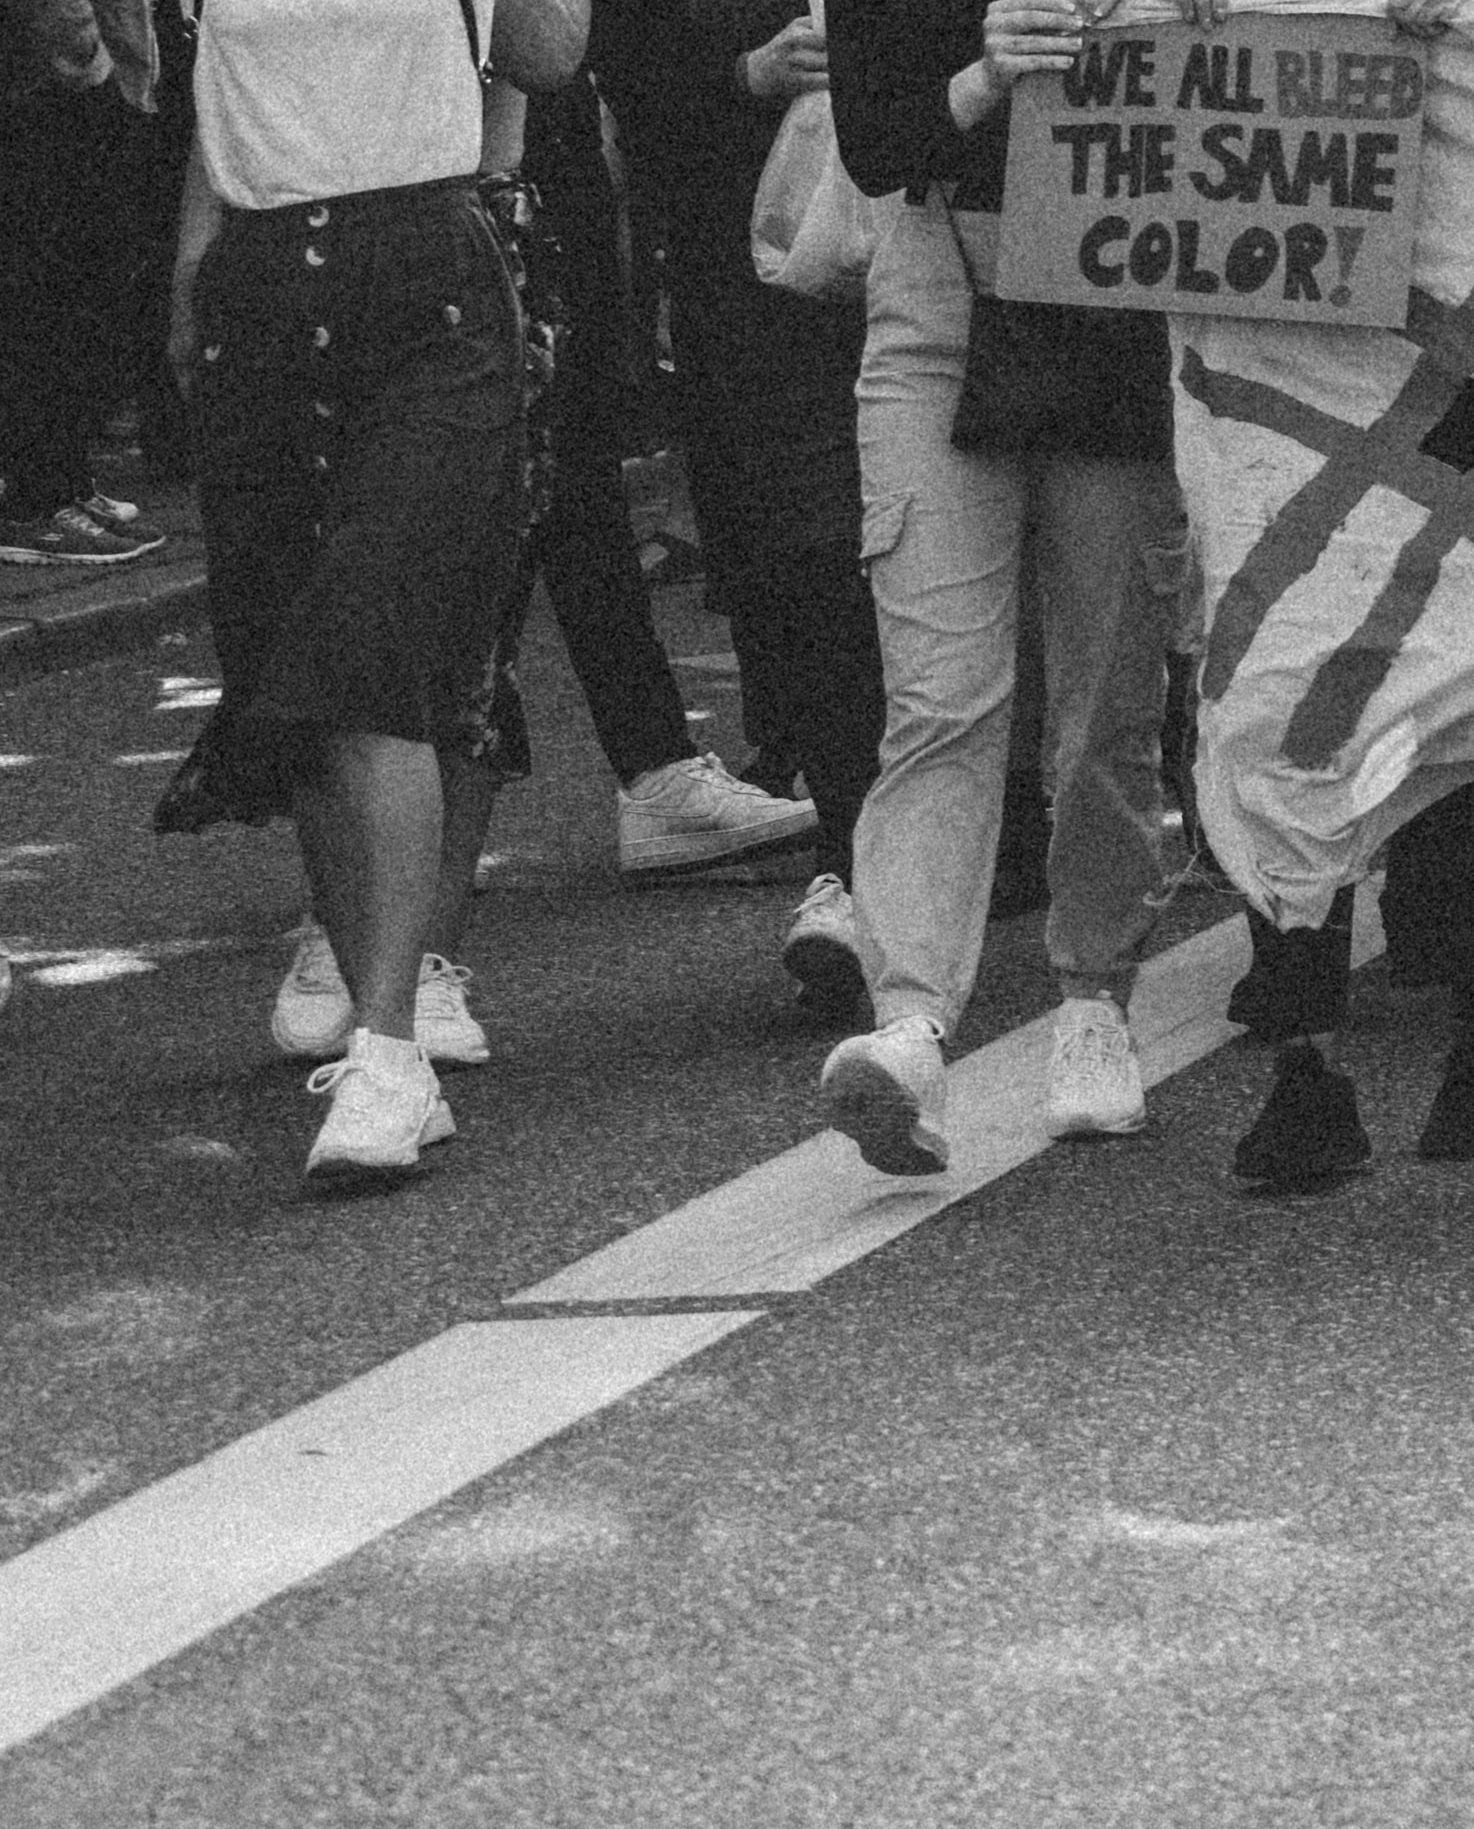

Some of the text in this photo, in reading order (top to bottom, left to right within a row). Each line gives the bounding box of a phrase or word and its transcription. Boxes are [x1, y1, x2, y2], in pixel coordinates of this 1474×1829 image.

[1062, 40, 1425, 121] WE ALL BLEED
[1051, 122, 1400, 213] THE SAME
[1078, 215, 1367, 309] COLOR!
